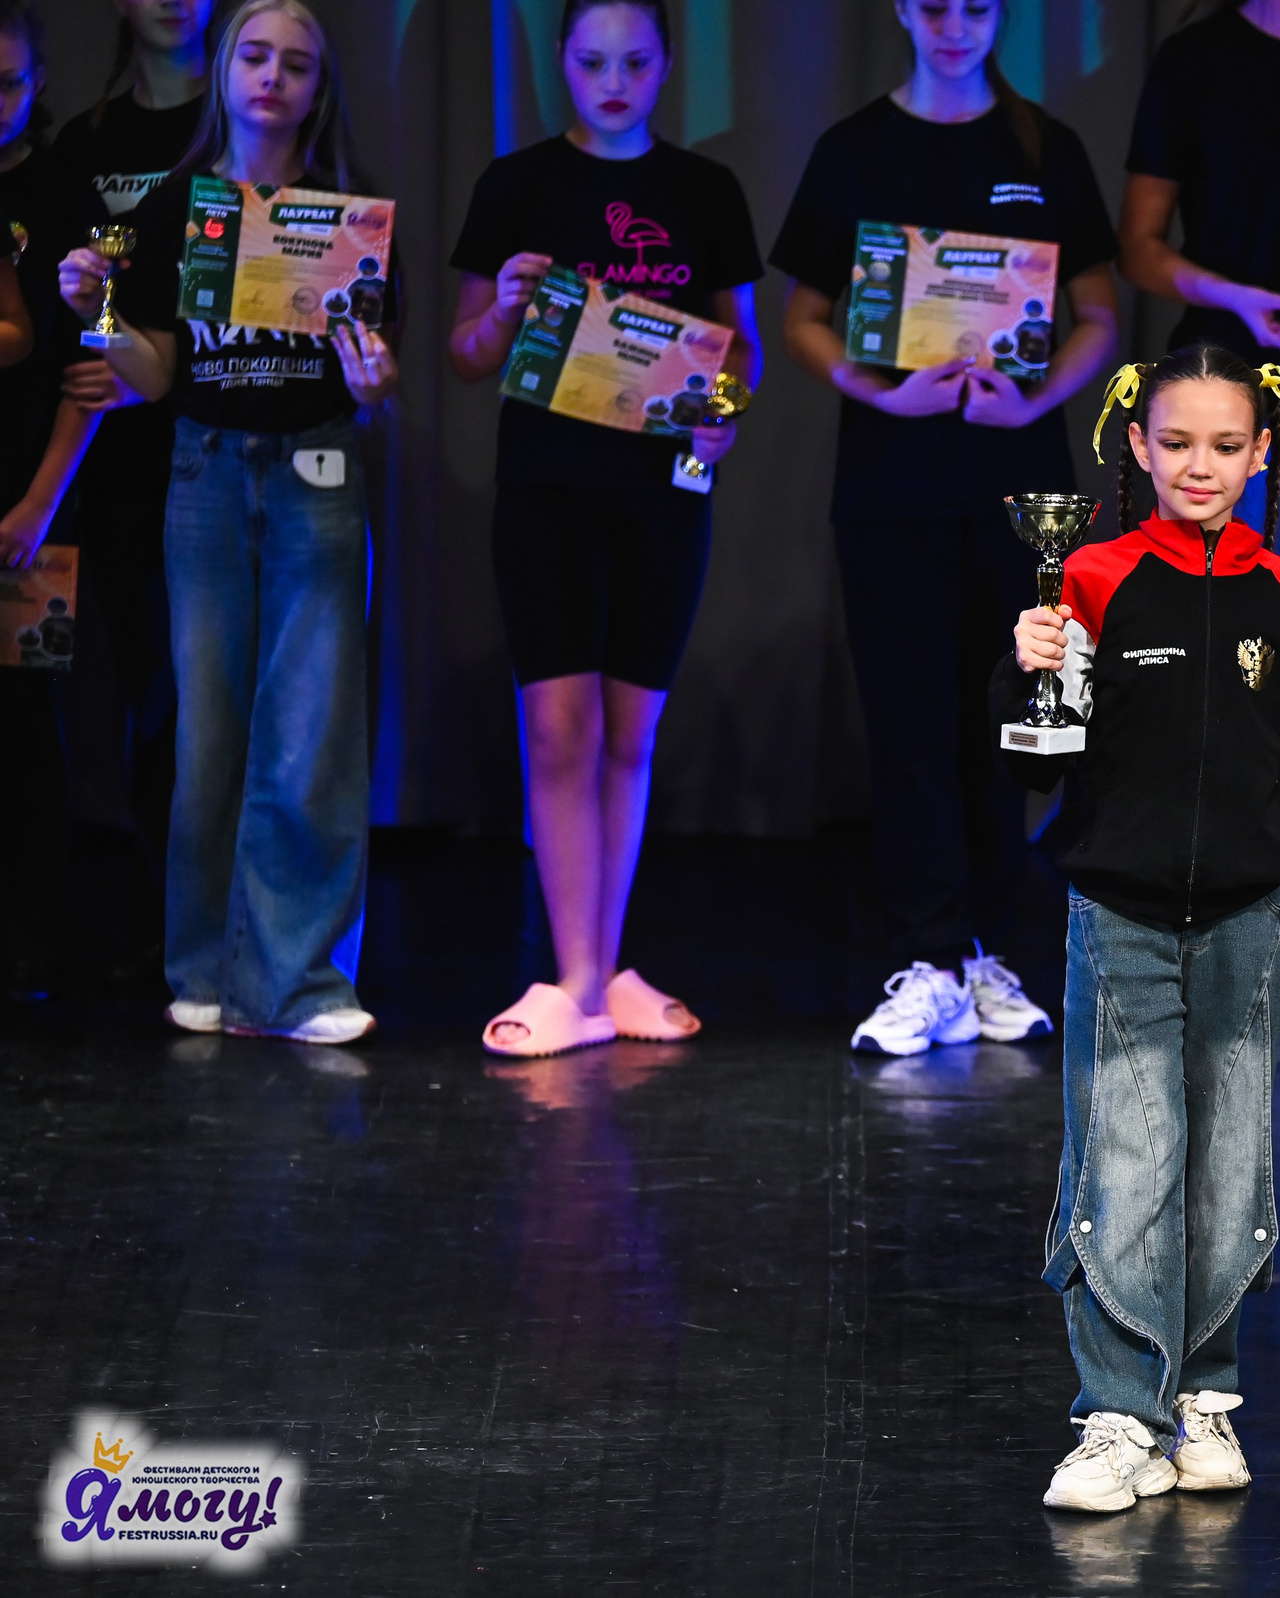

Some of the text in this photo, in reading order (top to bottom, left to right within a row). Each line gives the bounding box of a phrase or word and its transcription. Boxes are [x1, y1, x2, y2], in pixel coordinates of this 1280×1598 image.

[278, 207, 336, 221] ЛАУРЕАТ
[228, 356, 324, 374] ПОКОЛЕНИЕ
[1122, 647, 1186, 659] ФИЛЮШКИНА
[1138, 656, 1169, 666] АЛИСА
